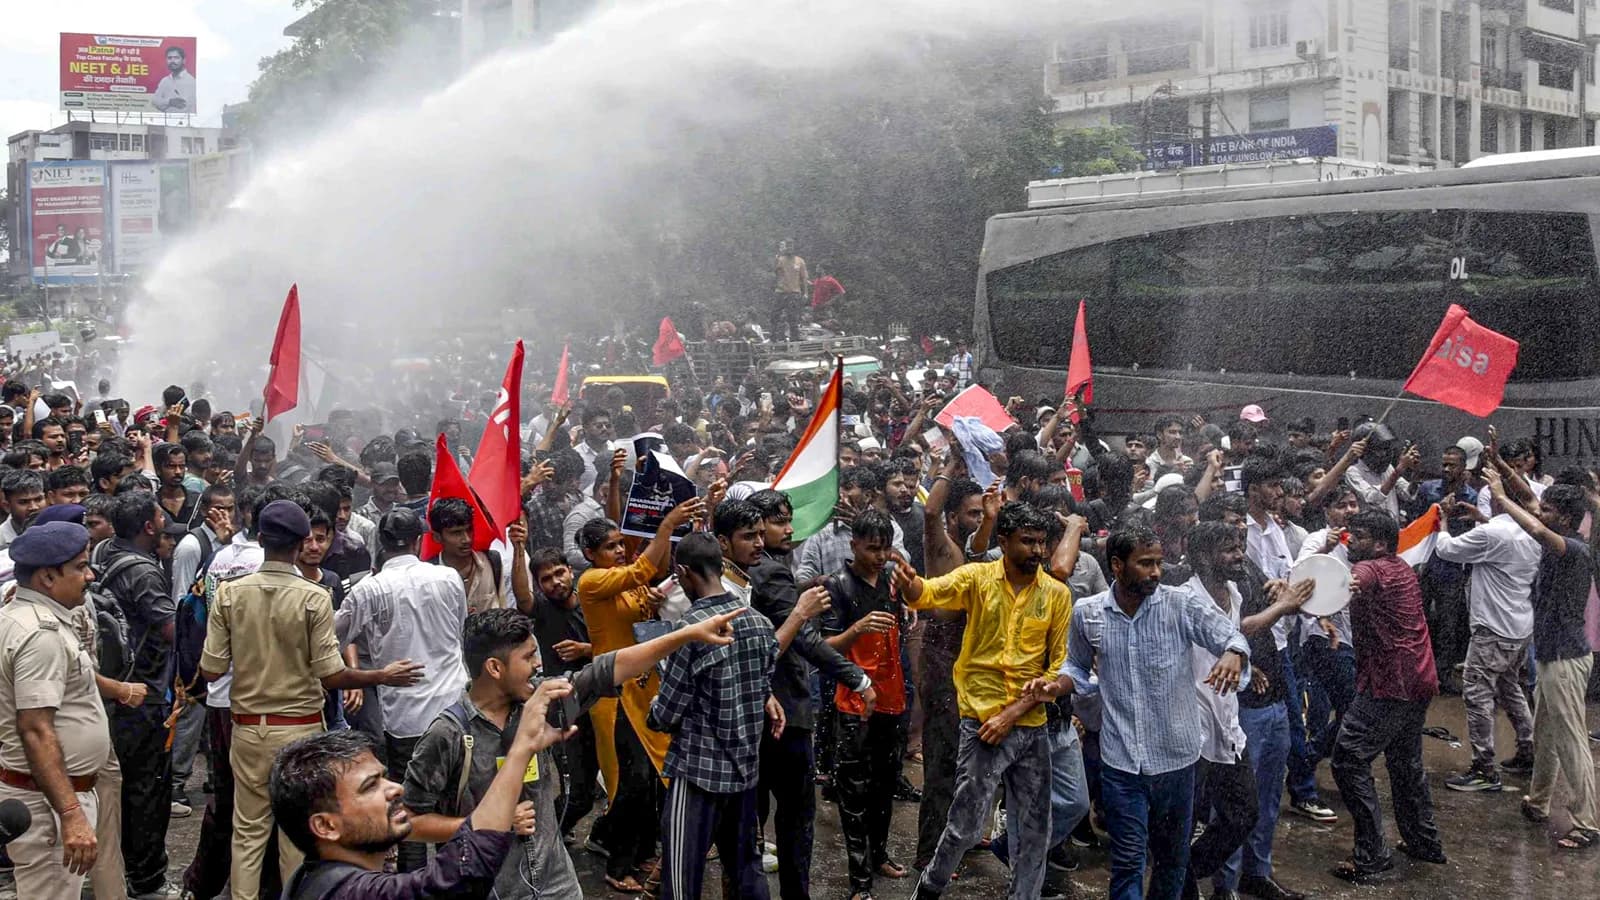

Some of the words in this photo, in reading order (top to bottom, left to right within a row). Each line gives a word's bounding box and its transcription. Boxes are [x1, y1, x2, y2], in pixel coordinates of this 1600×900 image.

[69, 62, 107, 74] NEET
[110, 63, 121, 74] &
[124, 64, 149, 75] JEE
[1200, 142, 1227, 154] SATE
[1228, 139, 1255, 152] BANK
[1256, 138, 1270, 148] OF
[1271, 135, 1297, 148] INDIA
[44, 167, 73, 178] NIET
[1434, 334, 1489, 376] aisa
